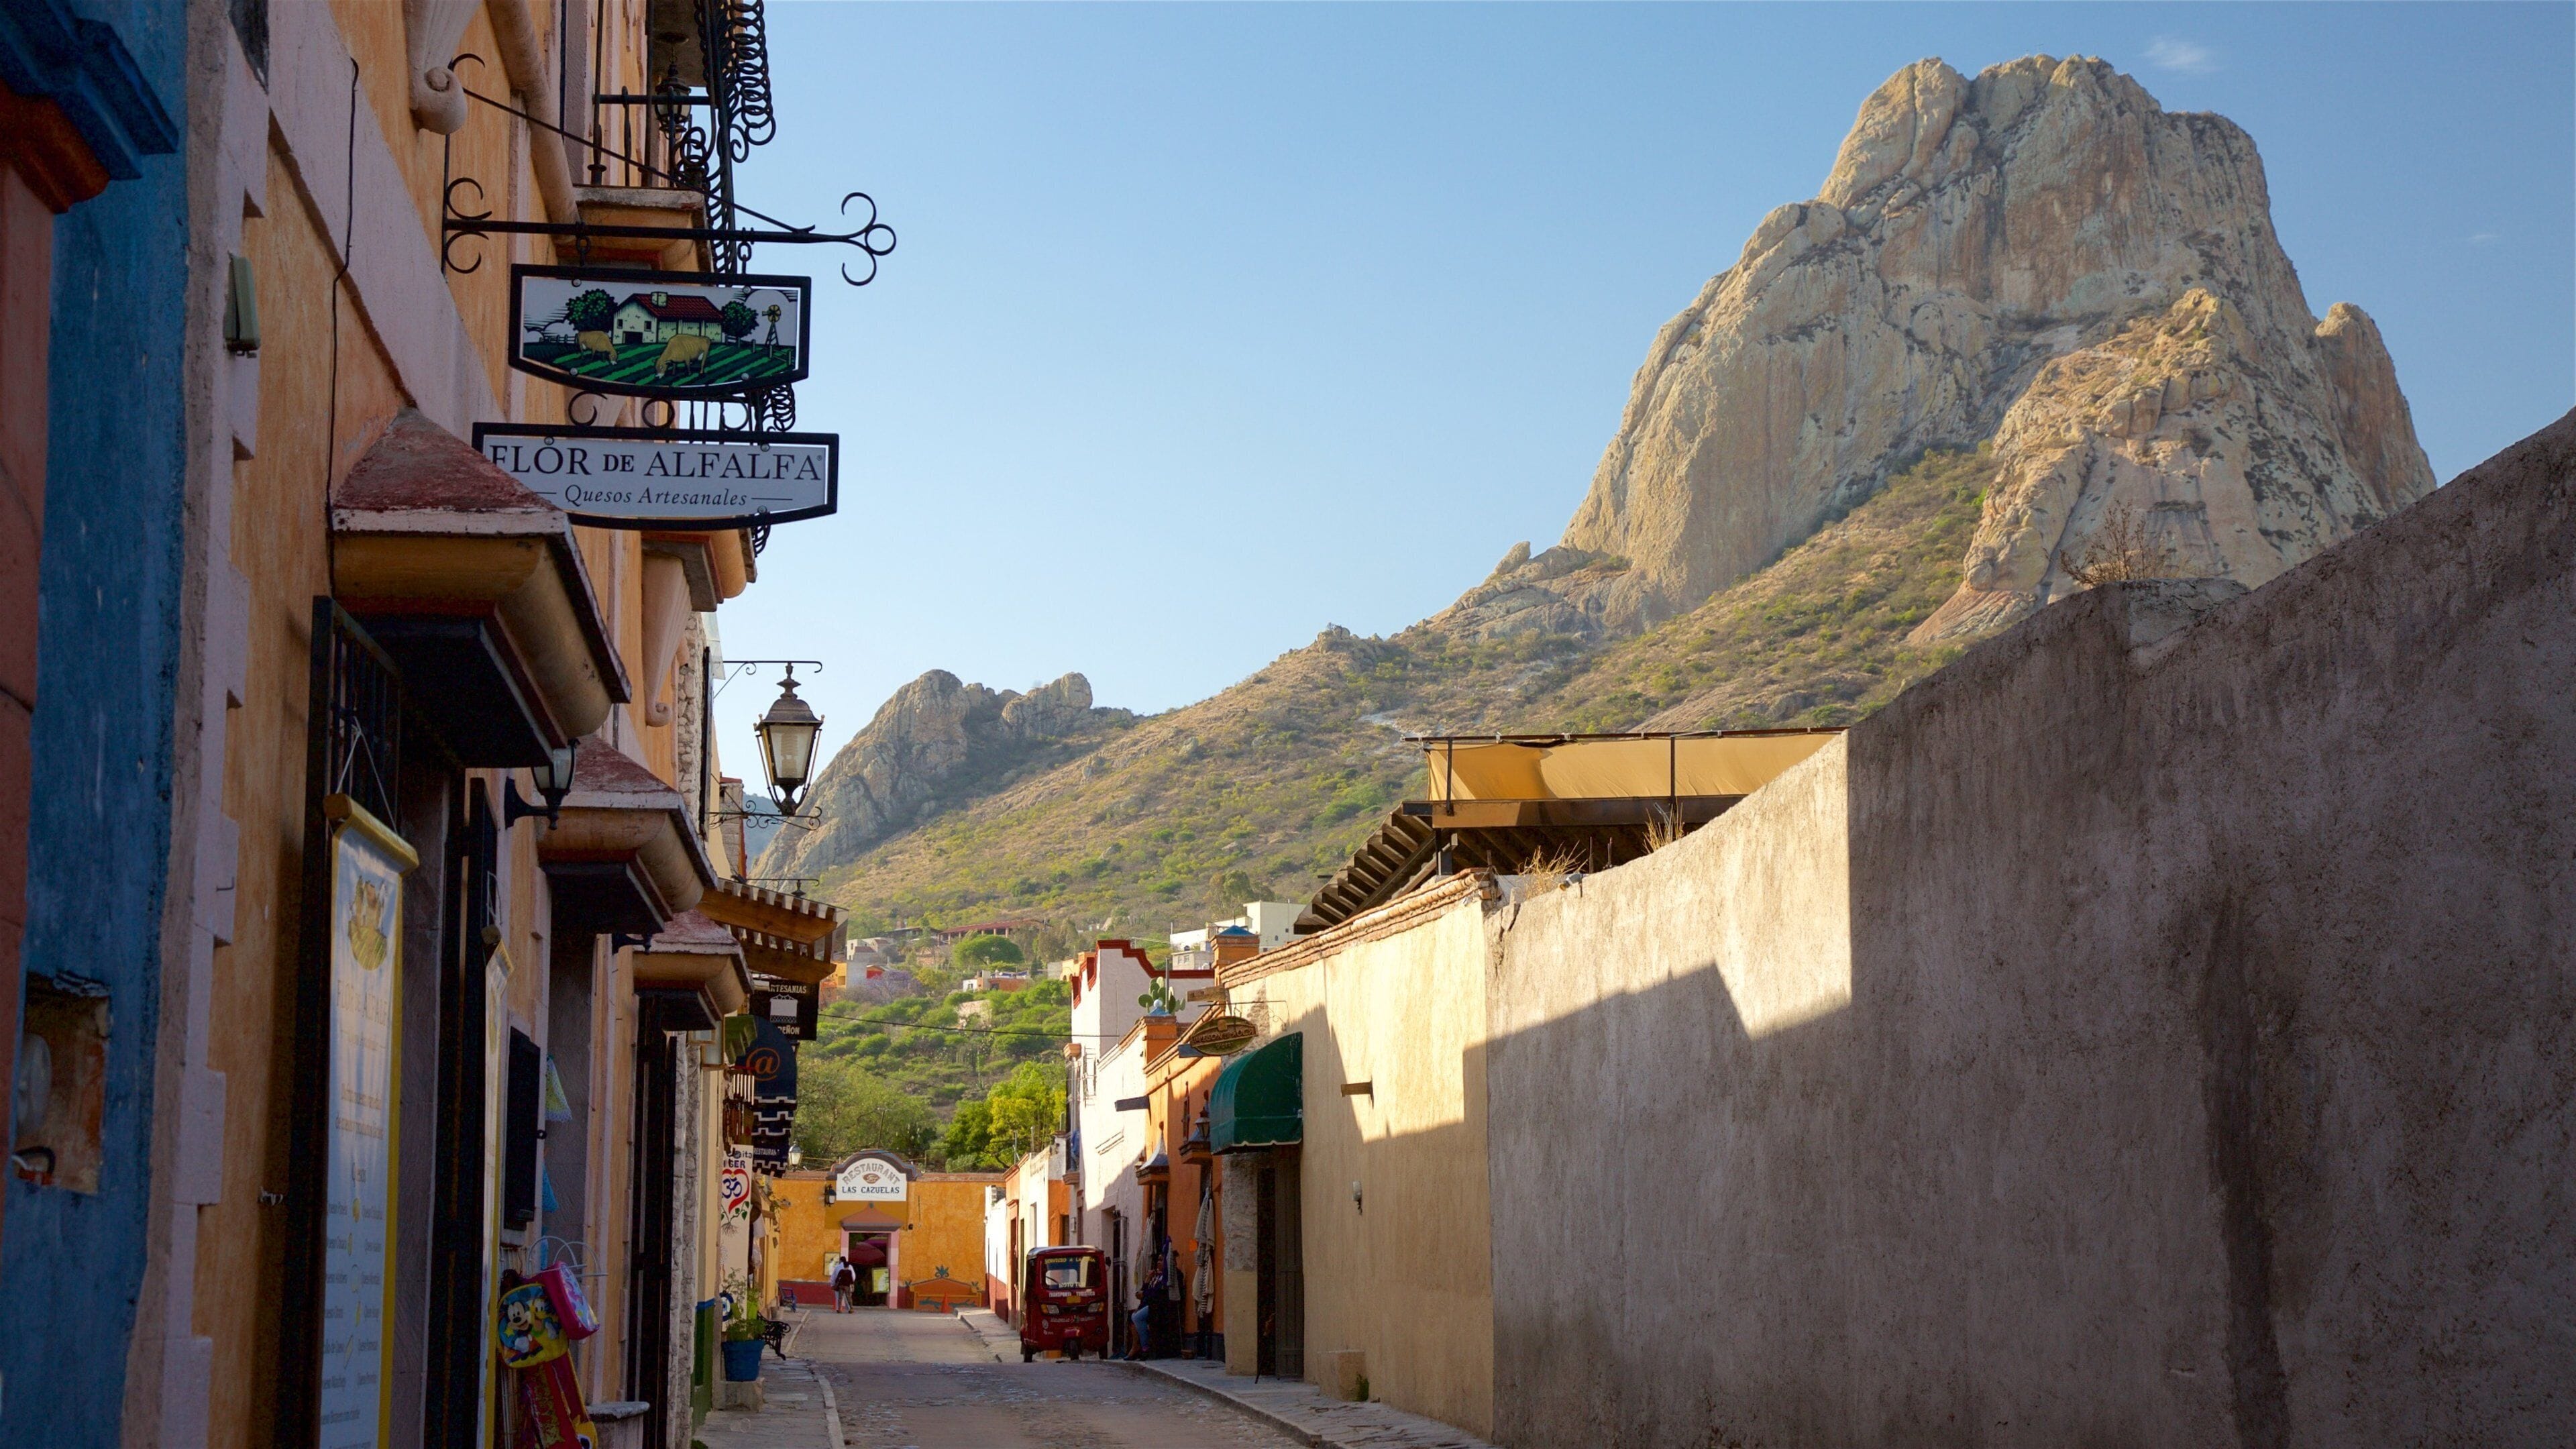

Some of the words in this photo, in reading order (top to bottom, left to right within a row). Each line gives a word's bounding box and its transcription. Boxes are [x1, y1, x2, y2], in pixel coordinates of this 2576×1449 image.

[489, 445, 592, 475] FLOR
[603, 454, 635, 472] DE
[565, 484, 631, 506] Quesos
[637, 486, 747, 506] Artesanales
[843, 1163, 900, 1185] RESTAURANT
